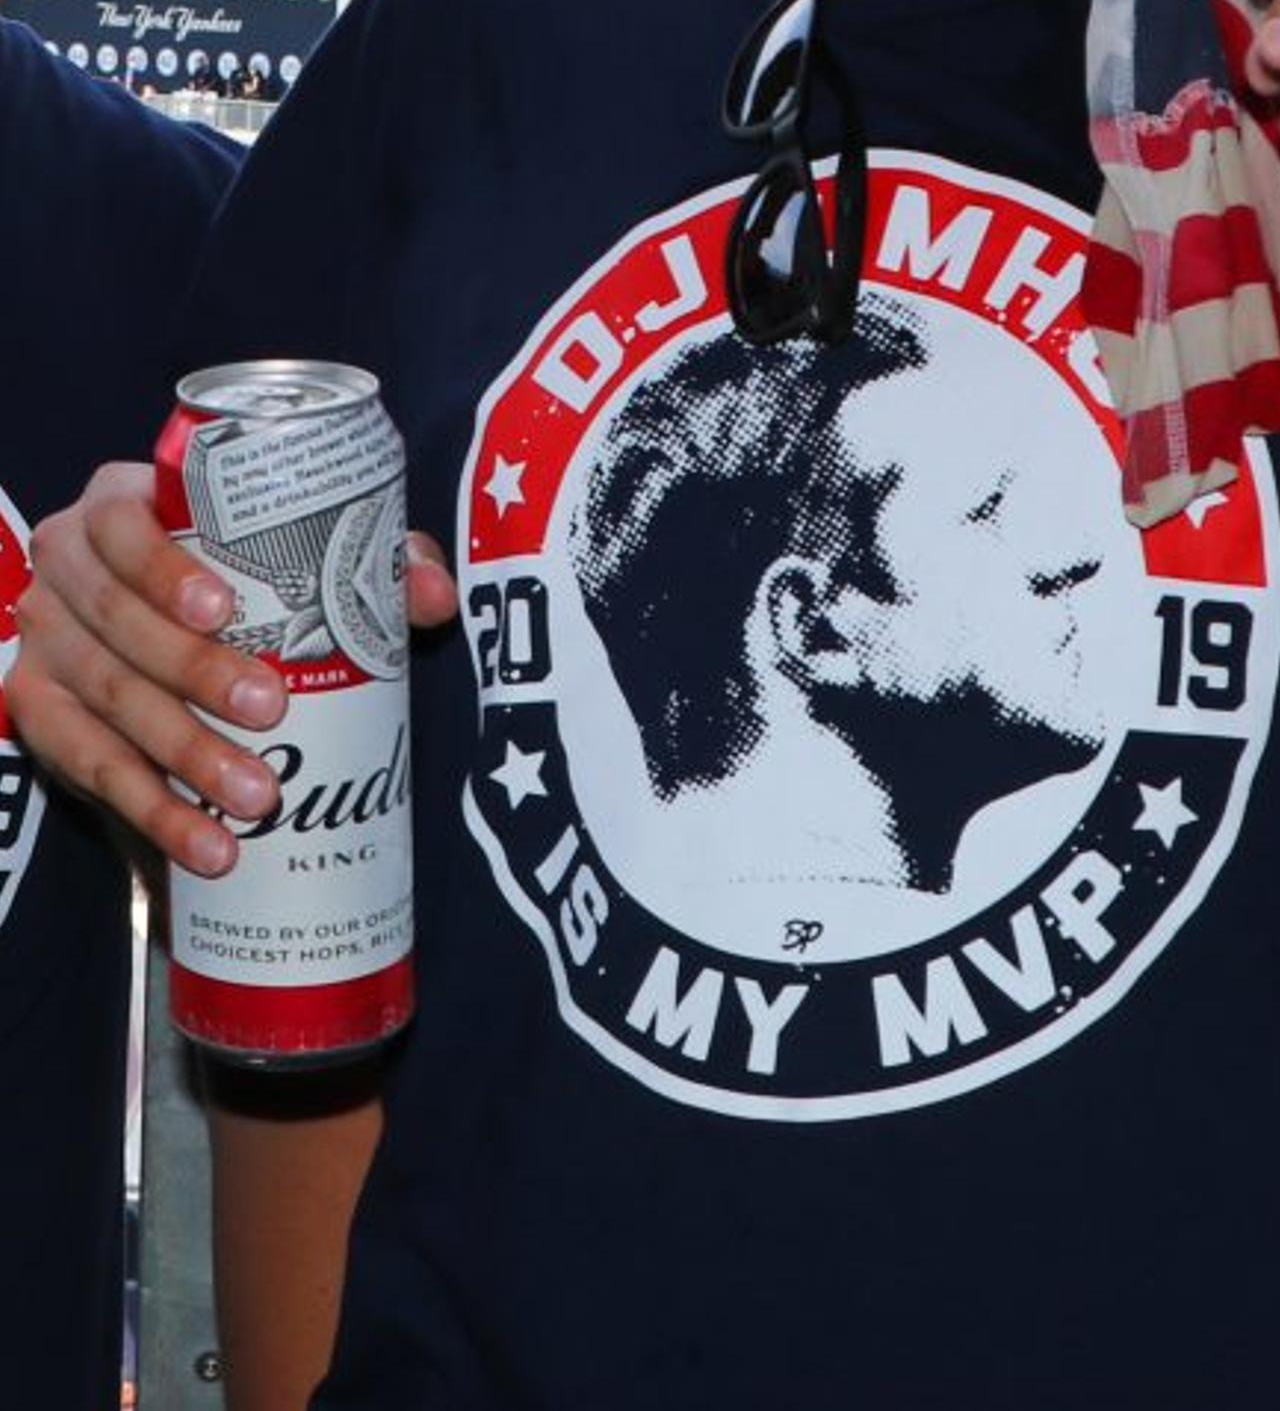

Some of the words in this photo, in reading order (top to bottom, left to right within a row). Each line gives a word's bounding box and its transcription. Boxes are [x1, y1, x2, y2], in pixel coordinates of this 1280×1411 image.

[96, 2, 133, 28] New
[133, 4, 172, 40] York
[174, 7, 242, 42] Yankees
[469, 575, 550, 686] 20
[1155, 595, 1254, 710] 19
[302, 670, 349, 689] MARK
[288, 844, 377, 873] KING
[189, 913, 271, 941] BREWED
[279, 927, 305, 941] BY
[315, 920, 360, 939] OUR
[189, 935, 291, 964] CHOICEST
[299, 941, 364, 964] HOPS,
[535, 825, 608, 966] IS
[624, 946, 809, 1074] MY
[872, 849, 1122, 1067] MVP
